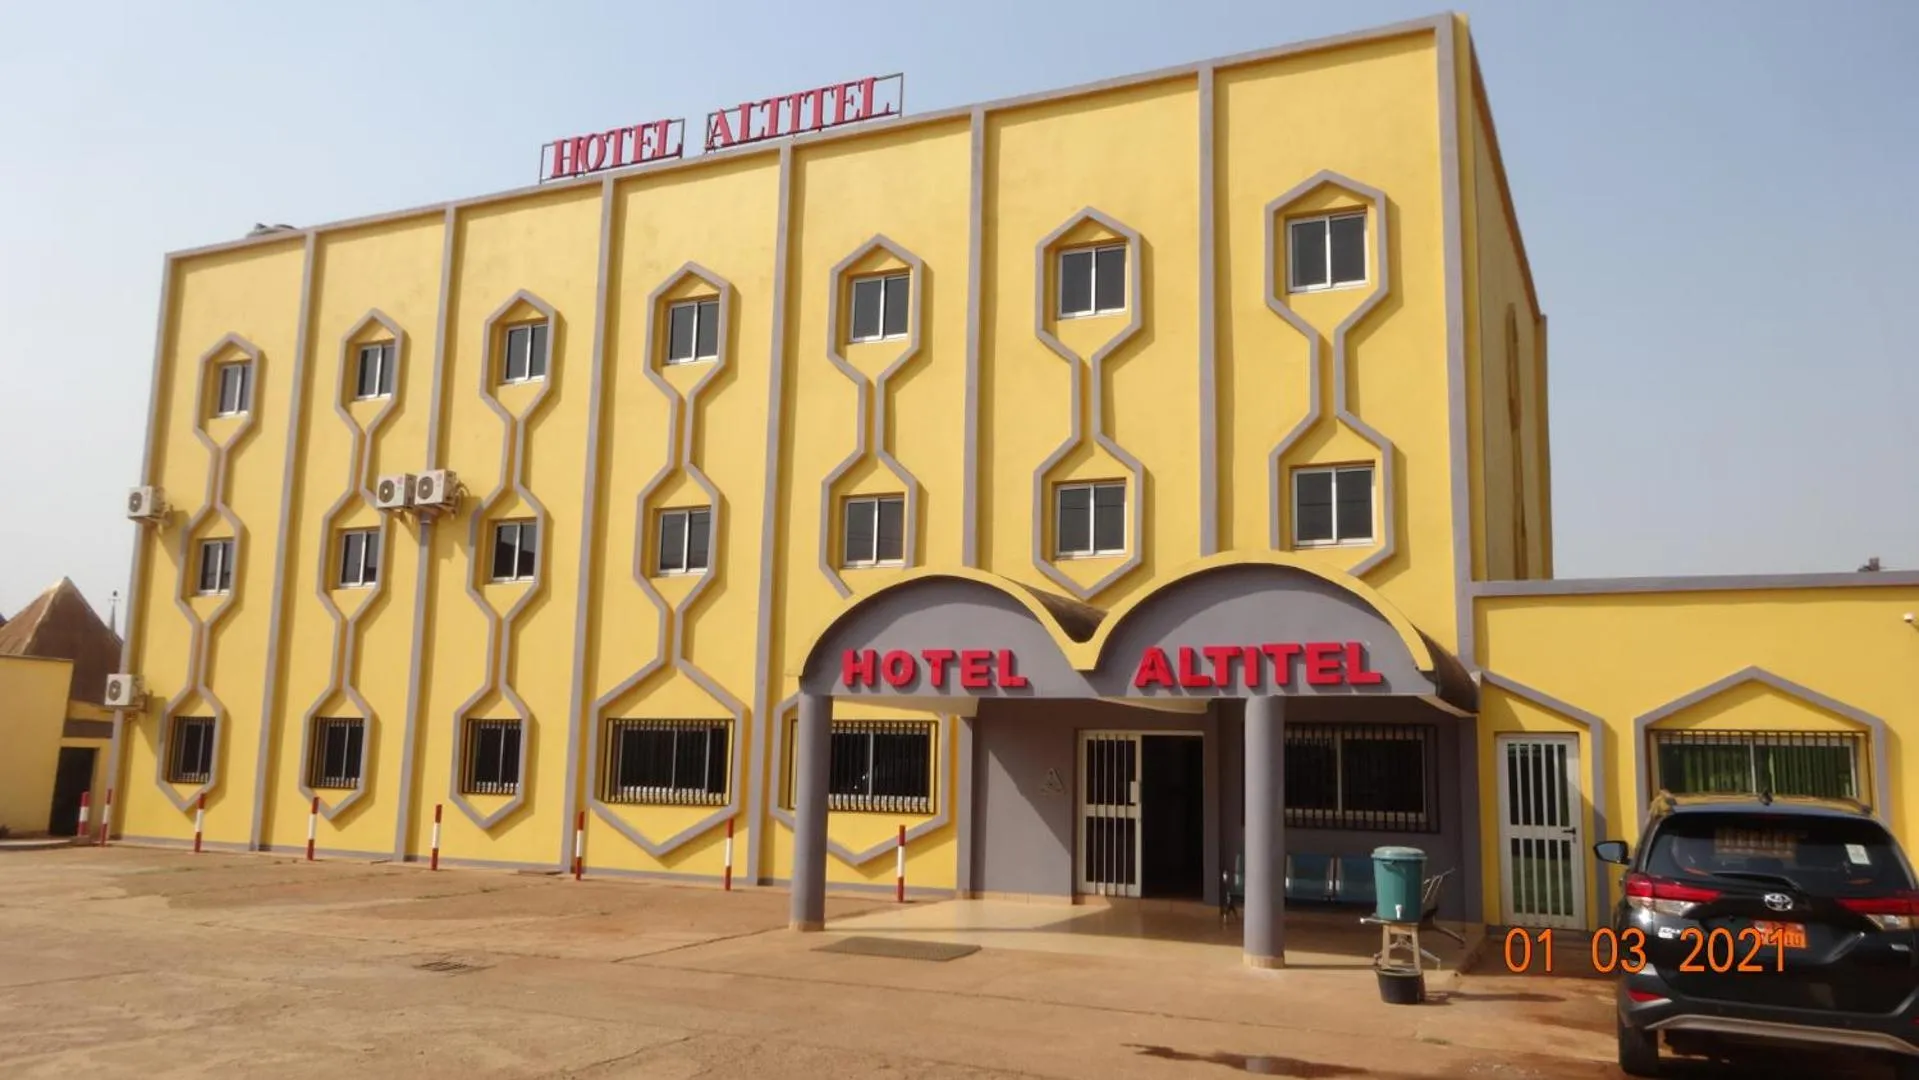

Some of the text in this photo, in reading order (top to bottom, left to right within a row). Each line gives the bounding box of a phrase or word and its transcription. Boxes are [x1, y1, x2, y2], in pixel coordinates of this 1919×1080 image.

[552, 77, 893, 178] HOTEL ALTITEL
[842, 641, 1384, 688] HOTEL ALTITEL
